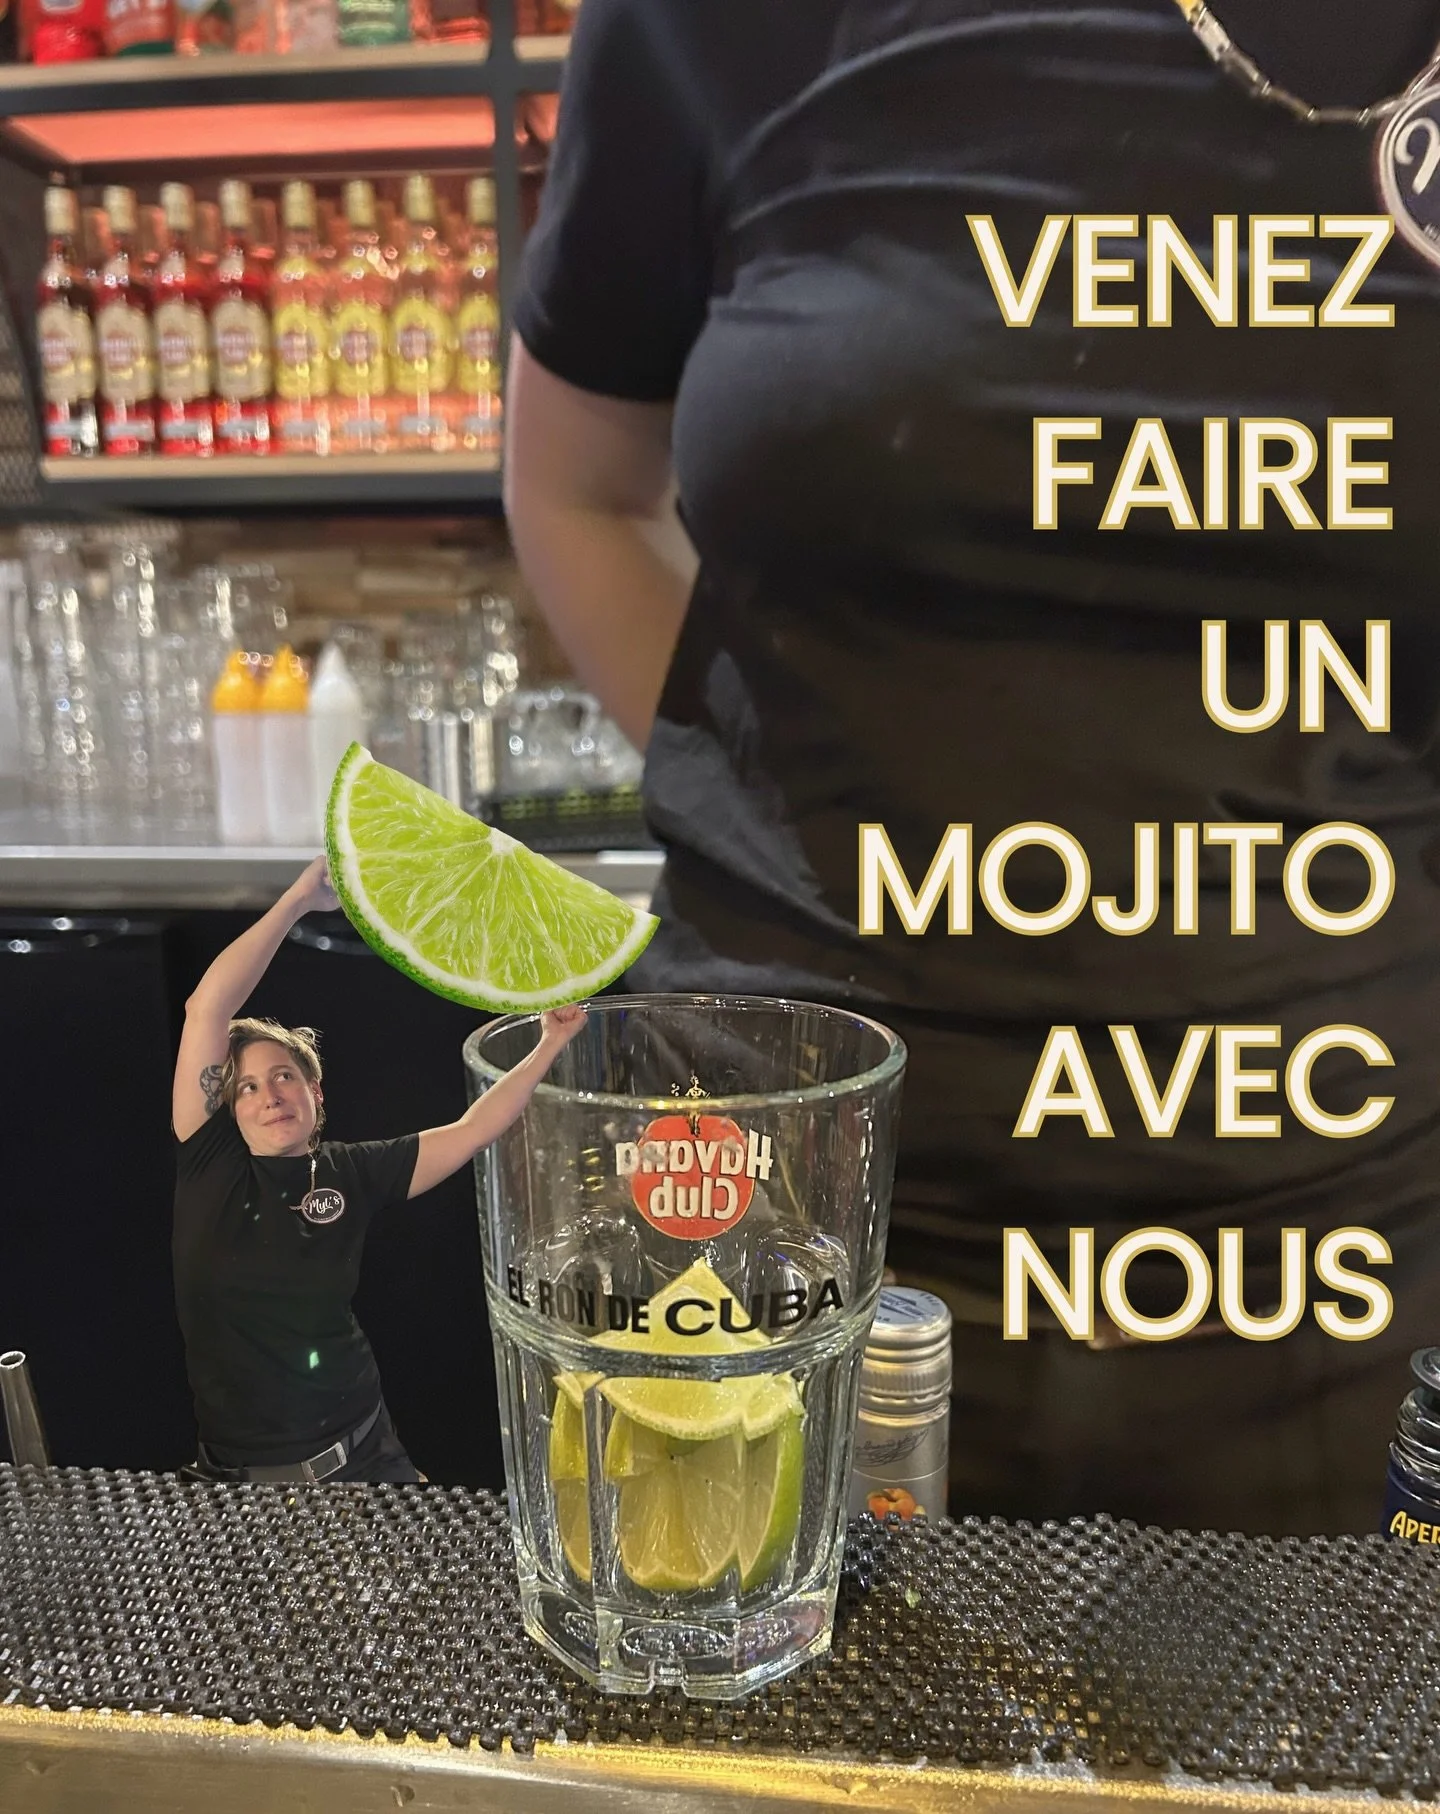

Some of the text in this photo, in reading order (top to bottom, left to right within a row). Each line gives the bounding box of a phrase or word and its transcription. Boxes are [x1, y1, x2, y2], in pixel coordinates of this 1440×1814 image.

[507, 1264, 531, 1309] EL
[538, 1278, 596, 1328] RON
[608, 1295, 651, 1334] DE
[664, 1277, 845, 1337] CUBA
